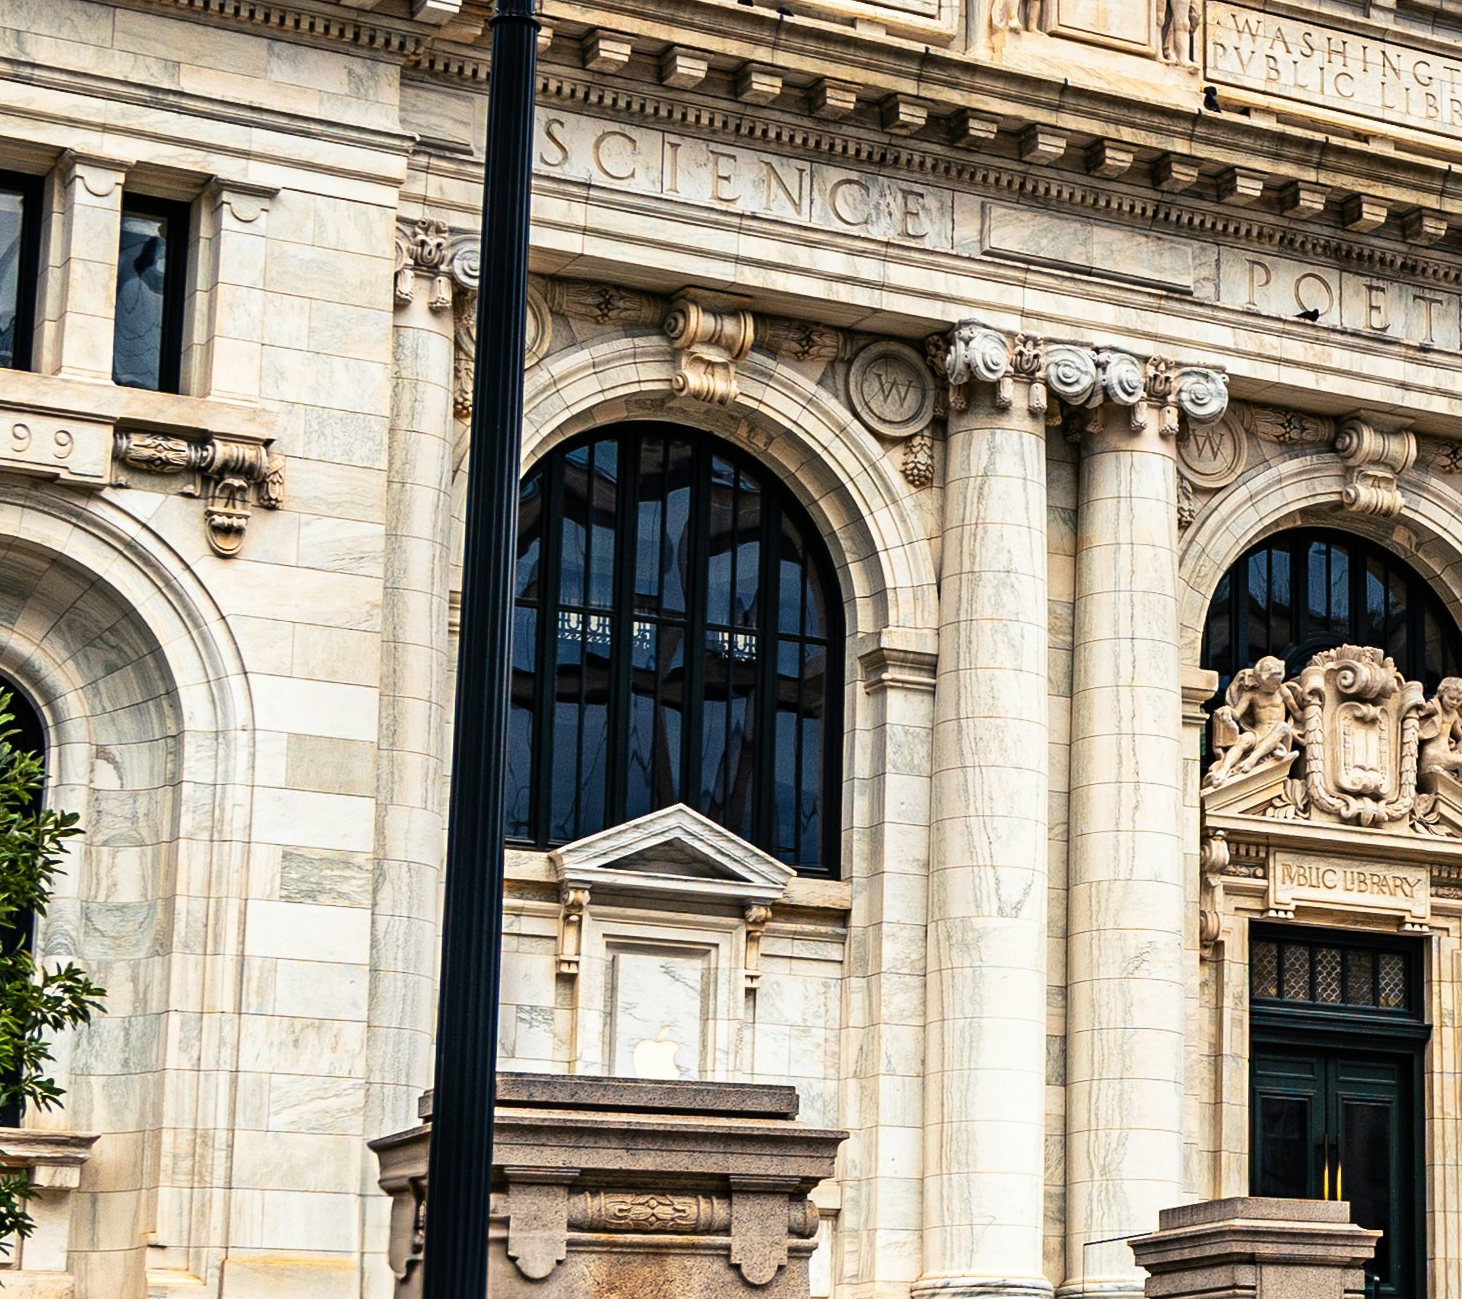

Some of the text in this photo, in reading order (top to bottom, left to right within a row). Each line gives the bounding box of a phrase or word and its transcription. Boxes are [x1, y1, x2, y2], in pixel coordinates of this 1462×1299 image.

[1210, 41, 1355, 100] PVBLIC
[539, 117, 930, 241] SCIENCE
[872, 371, 915, 408] W
[1188, 427, 1224, 462] W
